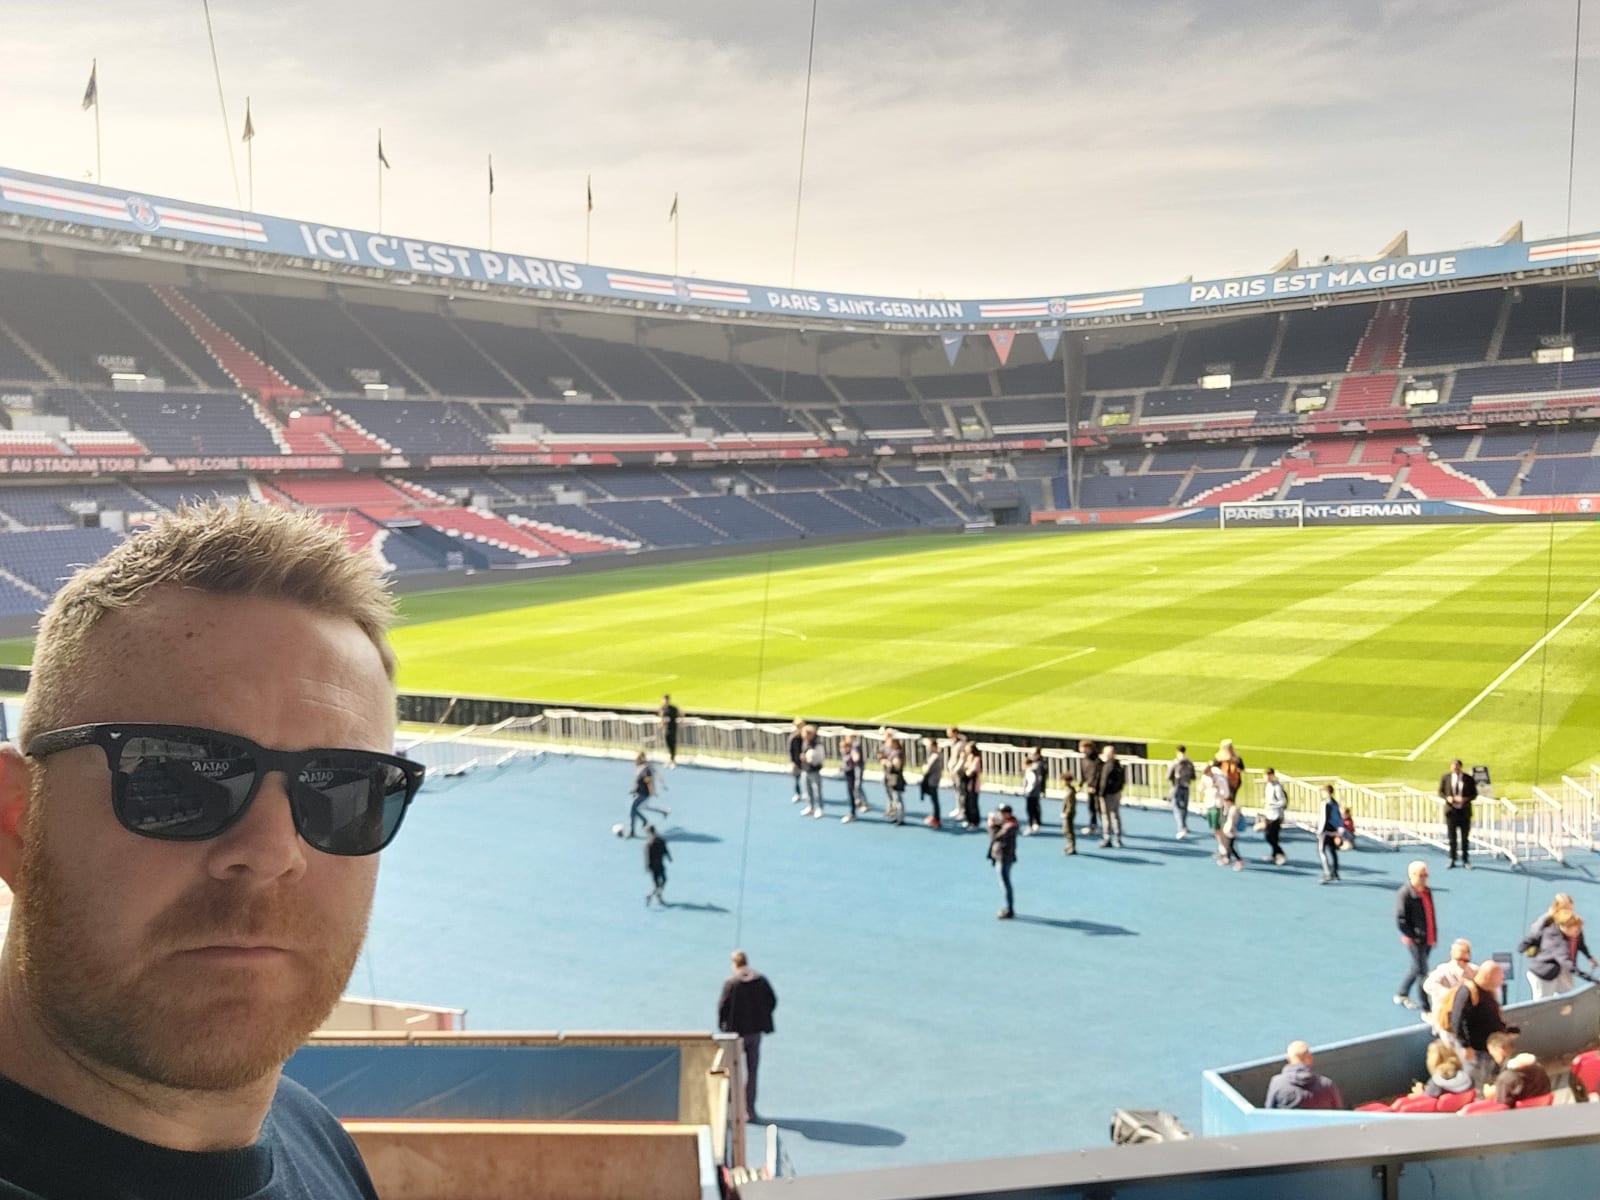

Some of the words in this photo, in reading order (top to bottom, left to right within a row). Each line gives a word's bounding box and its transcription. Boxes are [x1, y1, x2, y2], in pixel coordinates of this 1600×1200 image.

[300, 224, 359, 261] ICI
[367, 235, 472, 277] C'EST
[478, 252, 583, 290] PARIS
[1190, 279, 1266, 302] PARIS
[1272, 272, 1323, 294] EST
[1328, 256, 1457, 288] MAGIQUE
[767, 292, 821, 312] PARIS
[827, 298, 963, 318] SAINT-GERMAIN
[11, 458, 32, 472] AU
[34, 458, 98, 472] STADIUM
[100, 458, 135, 472] TOUR
[1225, 506, 1274, 520] PARIS
[1277, 503, 1421, 519] SANT-GERMAIN
